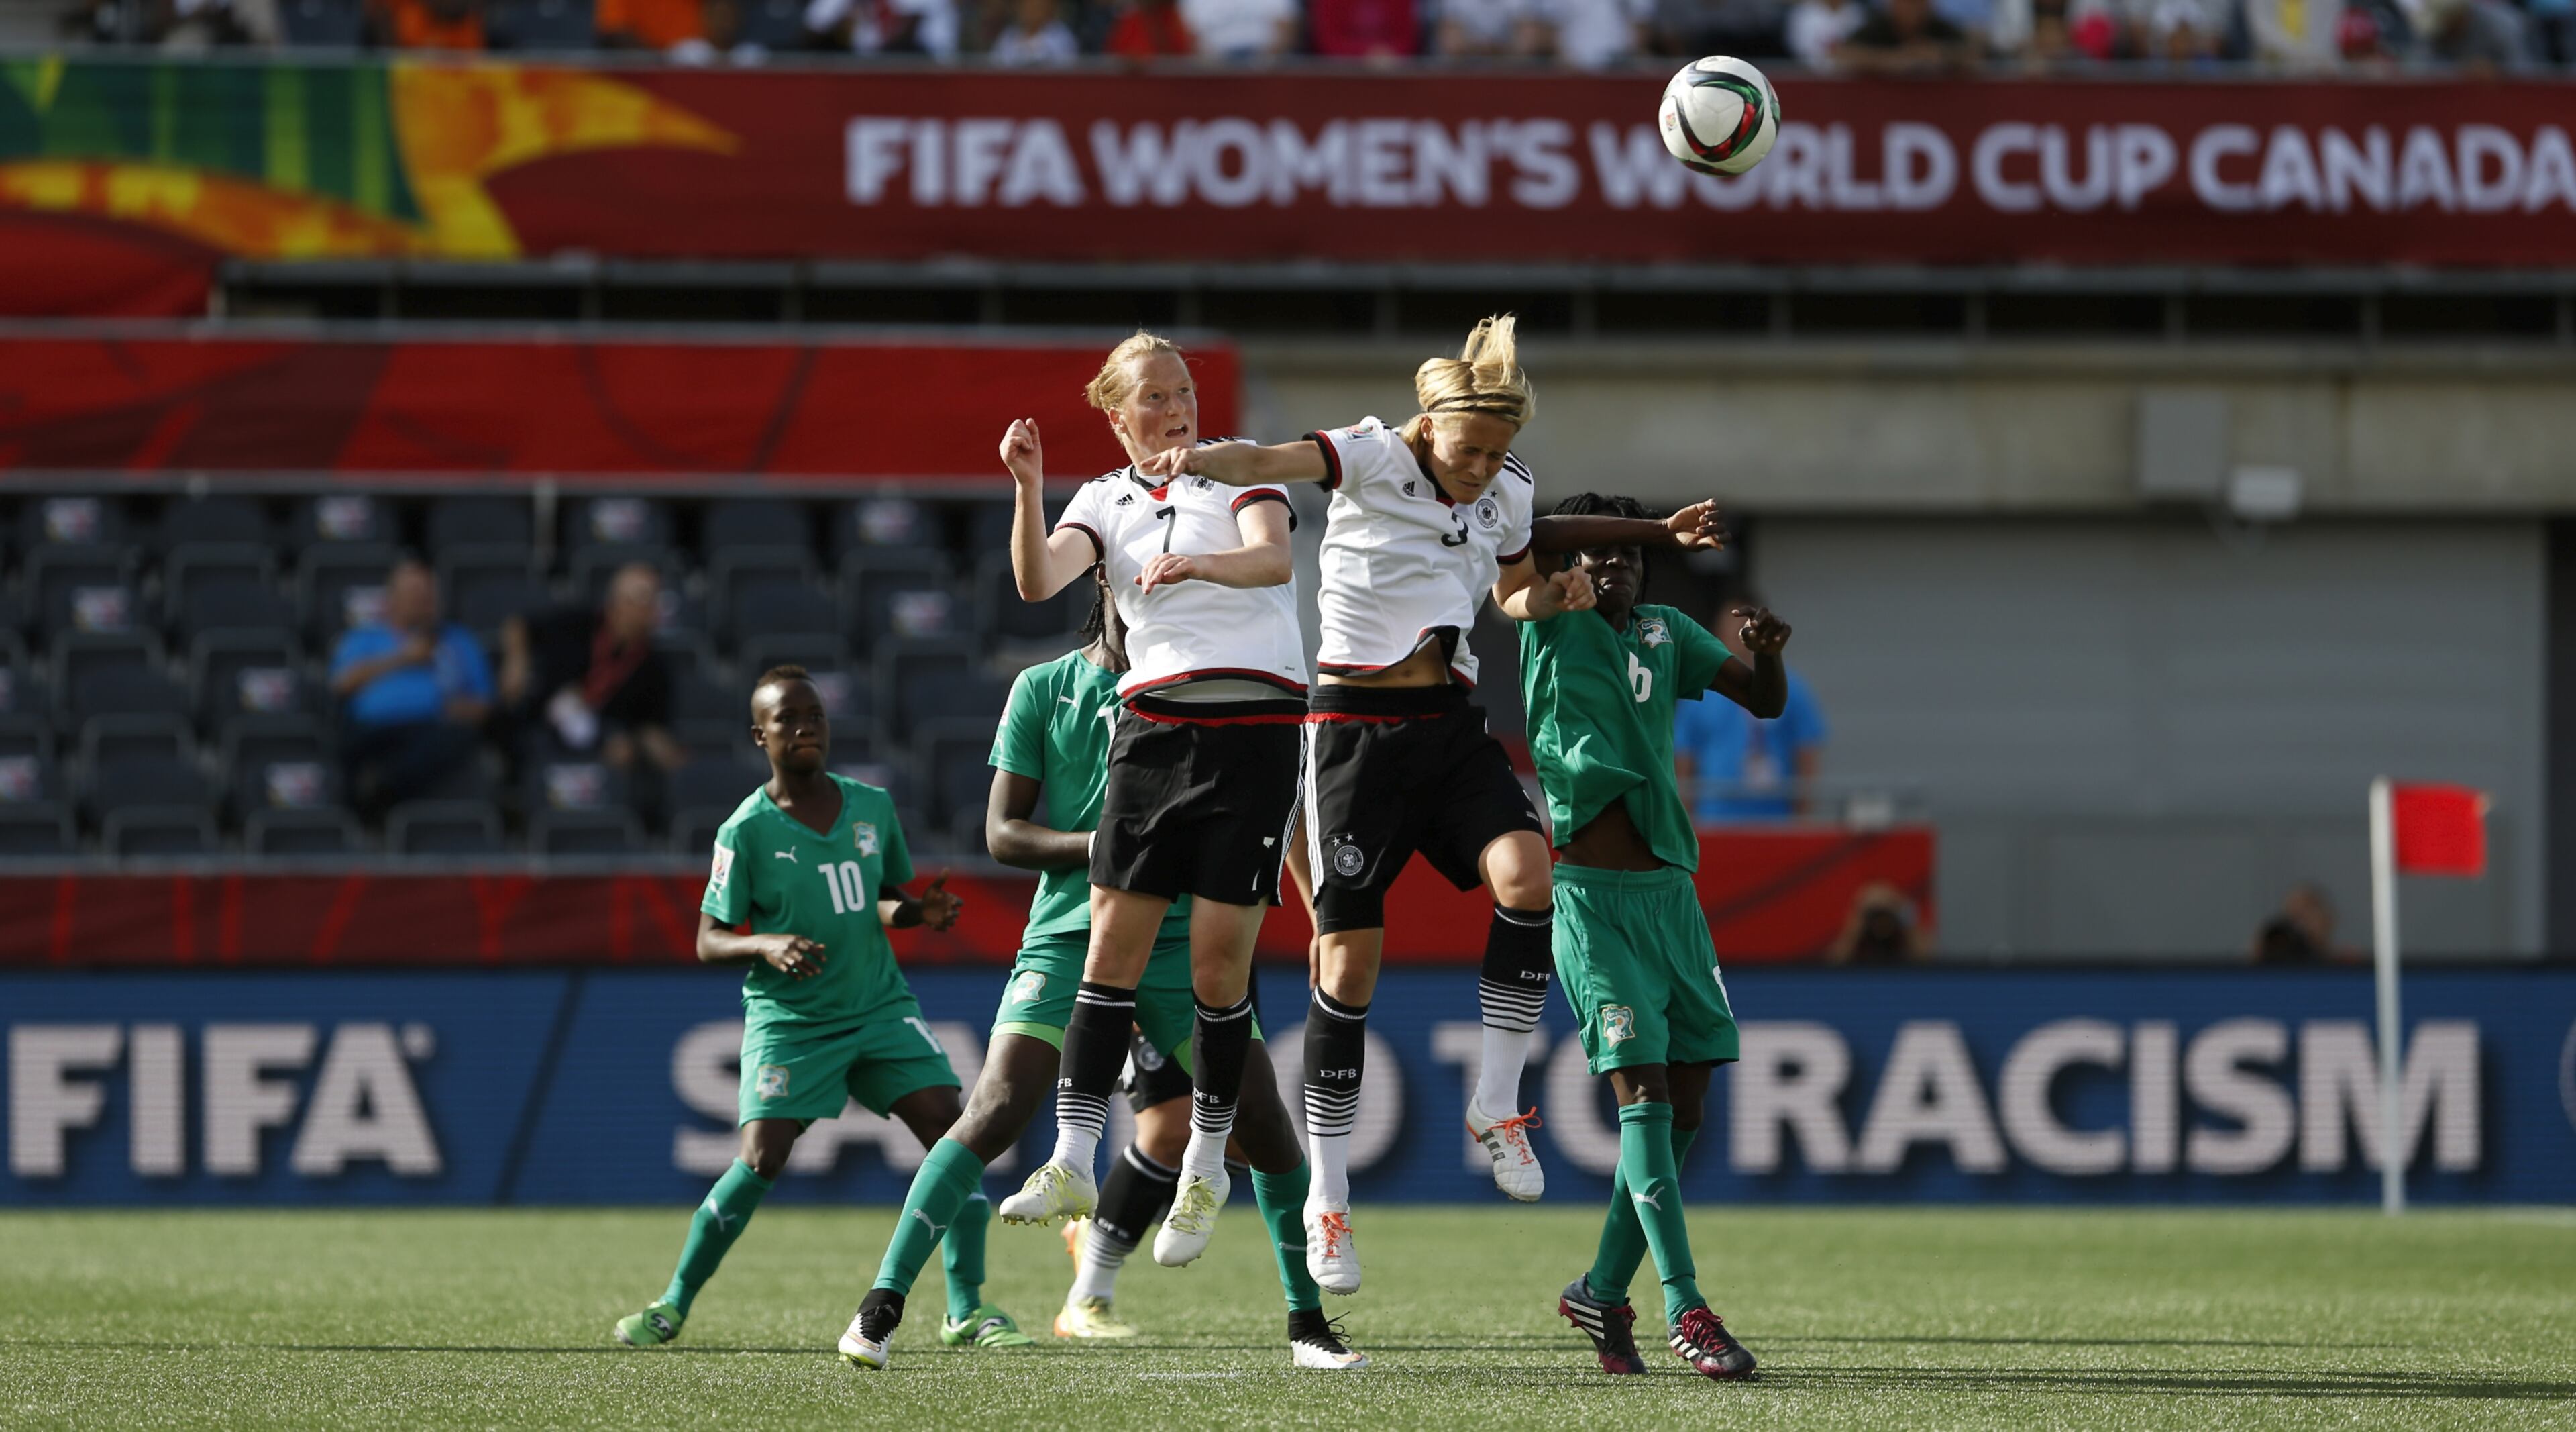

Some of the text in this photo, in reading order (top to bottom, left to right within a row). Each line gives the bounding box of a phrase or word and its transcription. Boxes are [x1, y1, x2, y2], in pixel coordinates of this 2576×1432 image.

[845, 117, 1087, 205] FIFA
[1092, 117, 1580, 208] WOMEN'S
[1971, 122, 2178, 212] CUP
[2188, 122, 2576, 213] CANADA
[1156, 505, 1176, 554] 7
[1441, 511, 1468, 547] 3
[818, 860, 865, 915] 10
[673, 1017, 1018, 1176] SA
[1729, 1018, 2481, 1174] RACISM
[1193, 1086, 1220, 1103] DFB
[1320, 1068, 1356, 1079] DFB
[7, 1024, 443, 1176] FIFA
